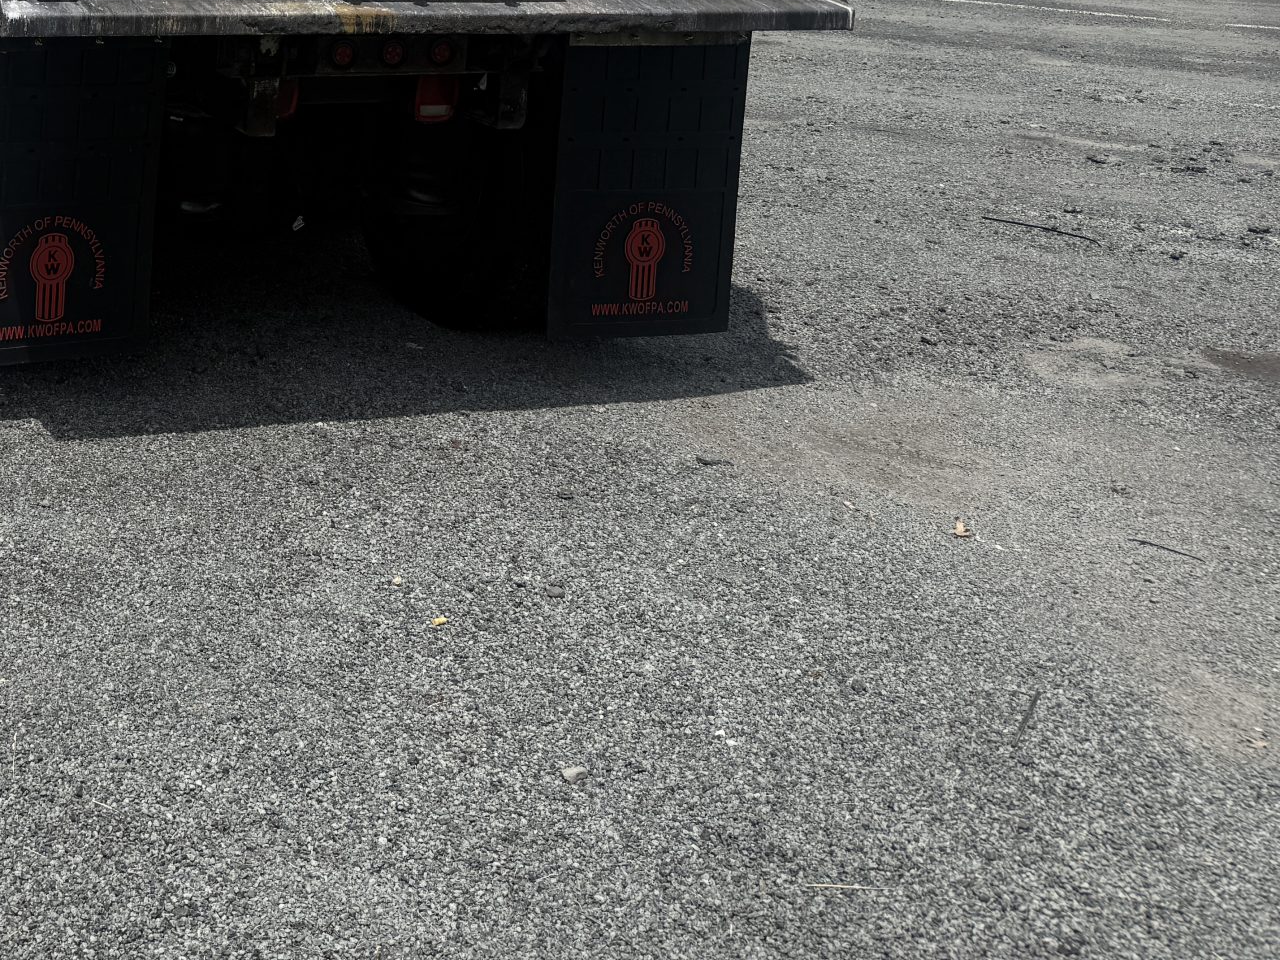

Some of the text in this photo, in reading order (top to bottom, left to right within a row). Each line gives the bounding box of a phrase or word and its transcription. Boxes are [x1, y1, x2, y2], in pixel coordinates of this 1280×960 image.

[34, 216, 52, 231] OF
[54, 215, 106, 290] PENNSYLVANIA
[593, 201, 694, 278] KENWORTH OF PENNSYLVANIA
[591, 300, 690, 316] WWW.KWOFPA.COM
